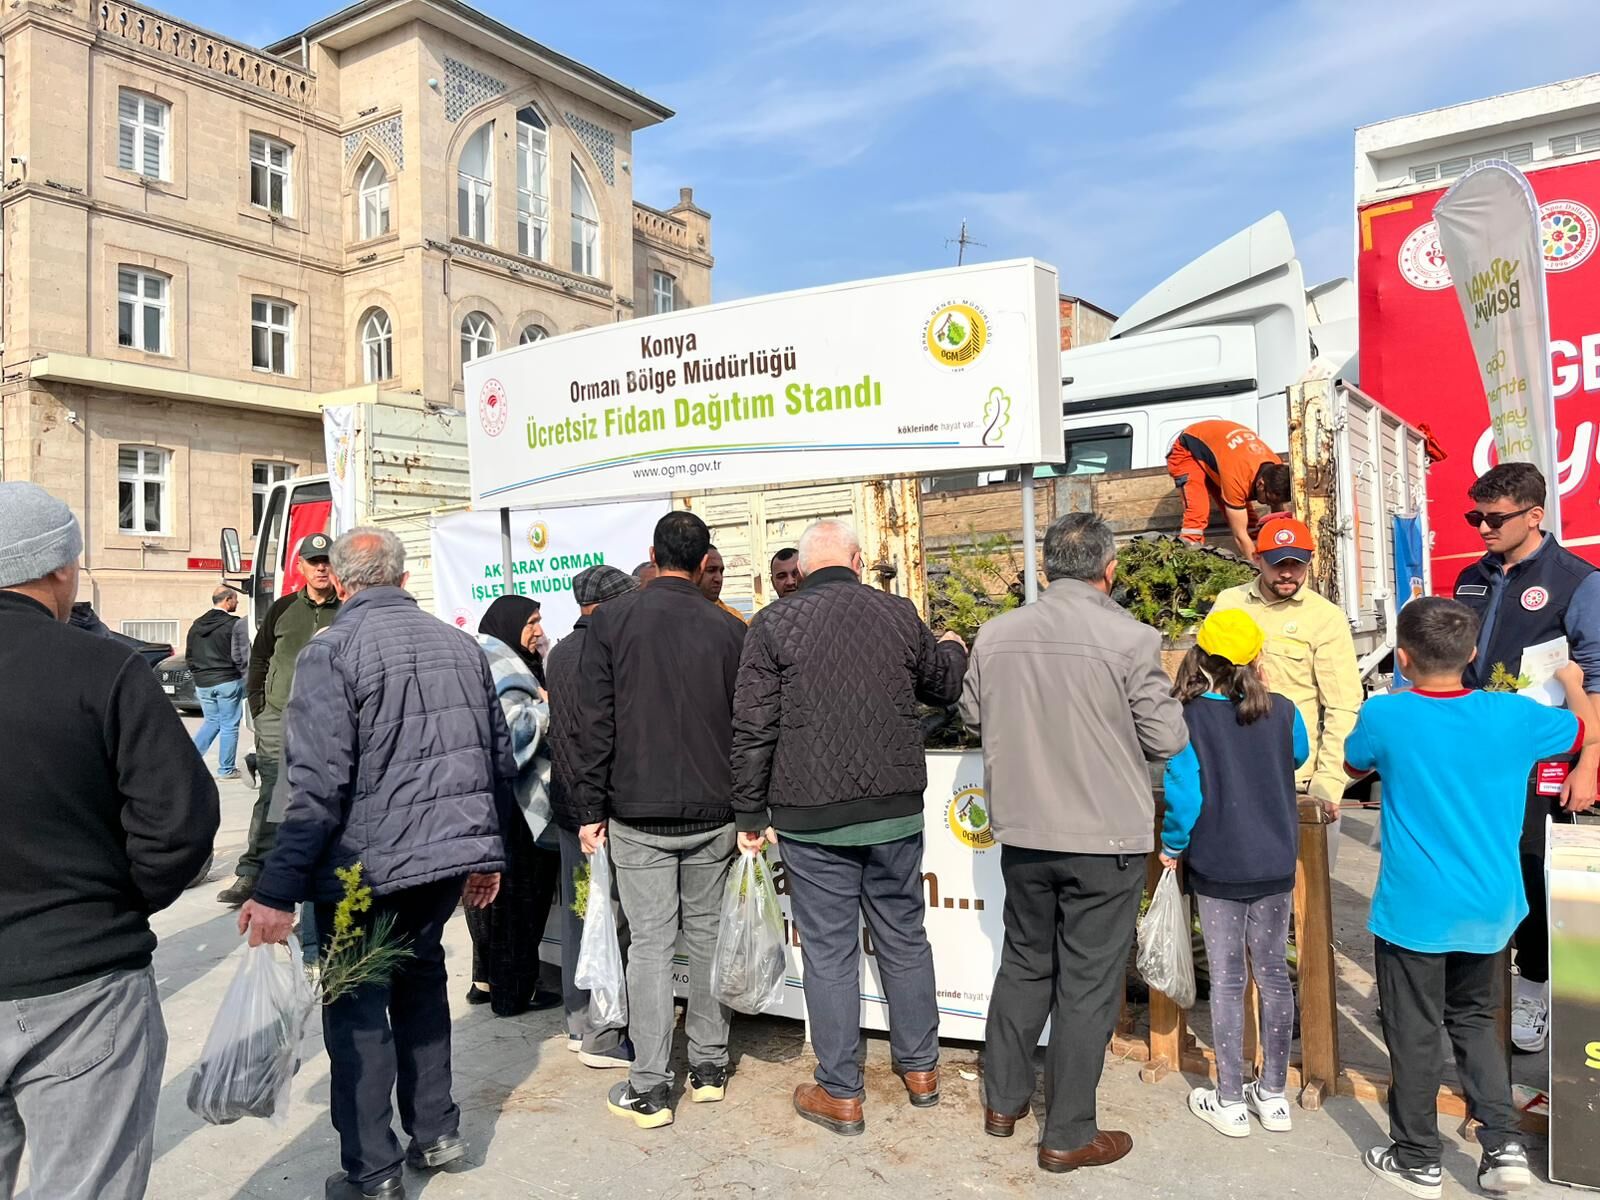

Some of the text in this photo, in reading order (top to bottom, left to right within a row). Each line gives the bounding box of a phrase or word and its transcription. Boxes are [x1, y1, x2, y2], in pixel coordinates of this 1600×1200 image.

[640, 333, 697, 359] Konya
[941, 350, 959, 361] OGM
[570, 346, 797, 403] Orman Bölge Müdürlüğü
[527, 375, 882, 449] Ücretsiz Fidan Dağıtım Standı
[897, 423, 939, 434] köklerinde
[940, 421, 960, 431] hayat
[633, 459, 723, 478] www.ogm.gov.tr
[485, 552, 604, 578] AKARAY ORMAN
[531, 574, 572, 594] MÜDÜ
[953, 783, 978, 796] GENEL
[962, 830, 980, 844] OGM
[936, 990, 962, 999] erinde
